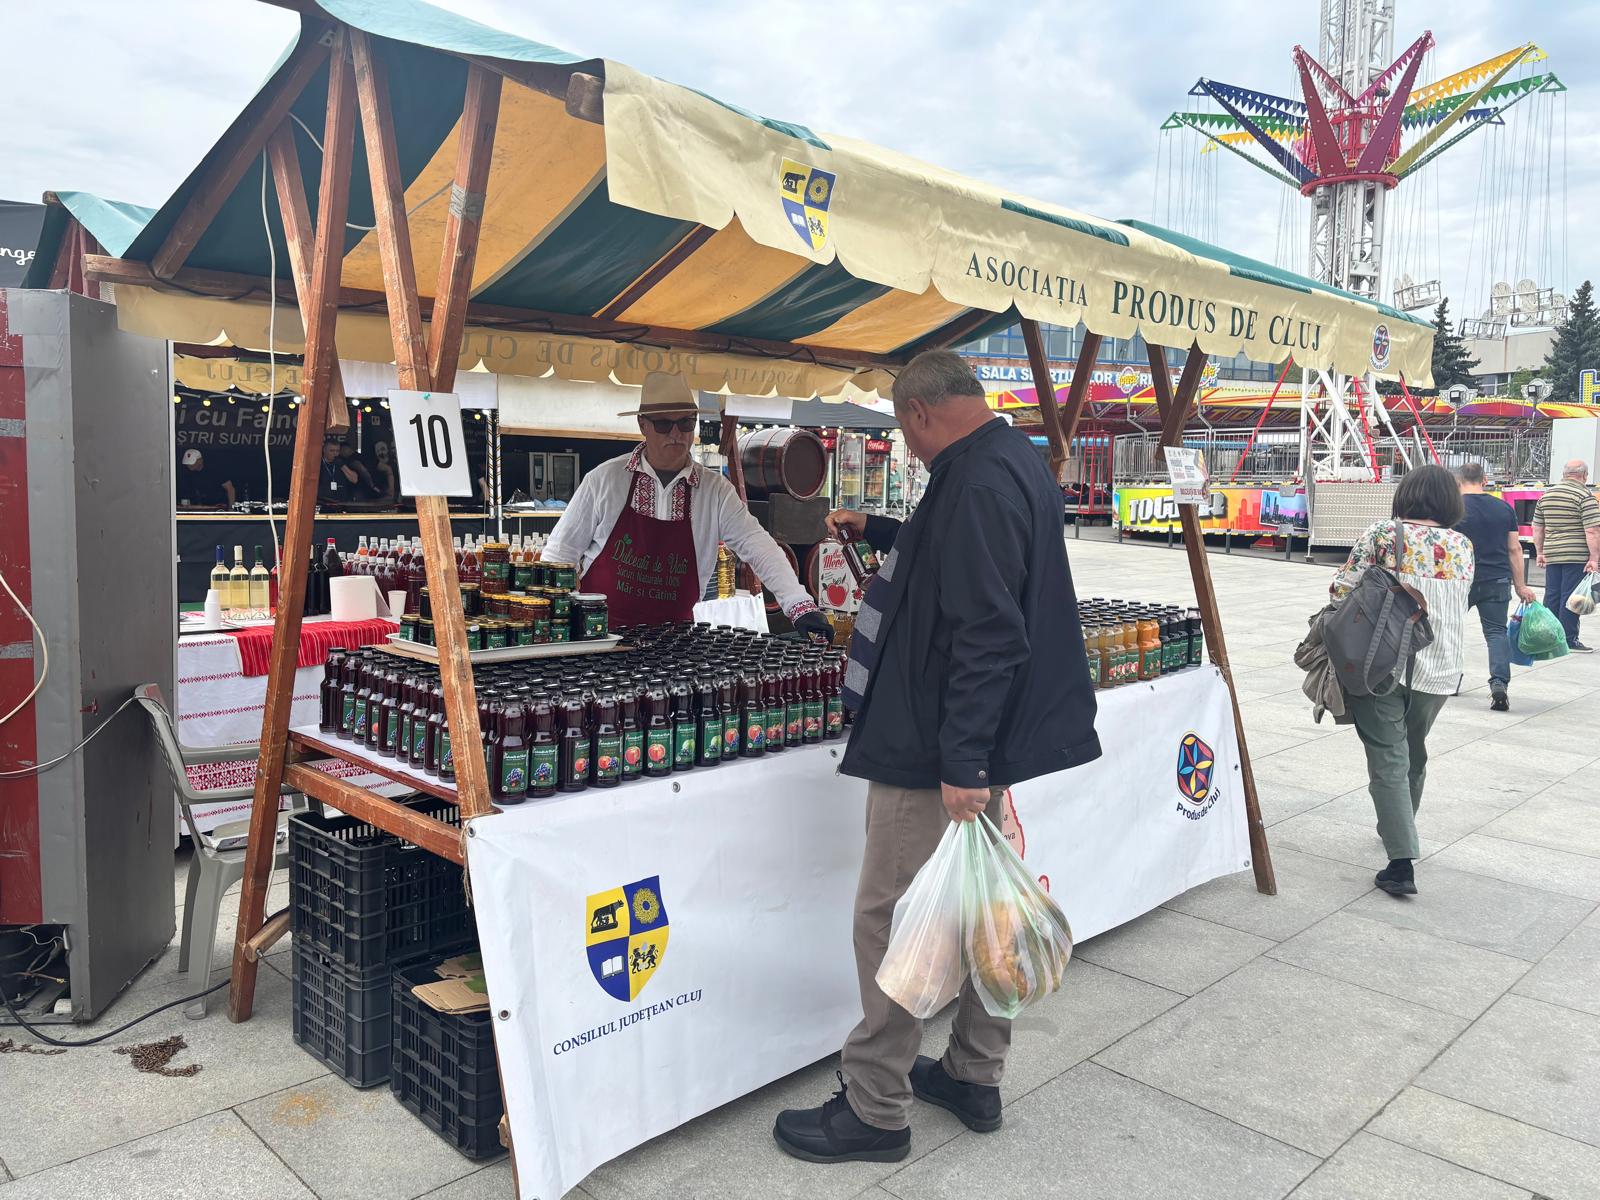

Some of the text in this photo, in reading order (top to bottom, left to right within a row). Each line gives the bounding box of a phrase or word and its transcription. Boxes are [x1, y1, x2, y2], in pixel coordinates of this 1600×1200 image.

[1111, 280, 1217, 334] PRODUS
[1228, 306, 1259, 341] DE
[1268, 315, 1322, 352] CLUJ
[981, 366, 1017, 380] SALA
[196, 410, 226, 427] cu
[219, 432, 263, 445] SUNT
[268, 434, 292, 446] DIN
[409, 413, 453, 469] 10
[1176, 802, 1201, 820] Produs
[1207, 786, 1221, 809] Cluj
[553, 1021, 617, 1056] CONSILIUL
[676, 988, 703, 1007] CLUJ
